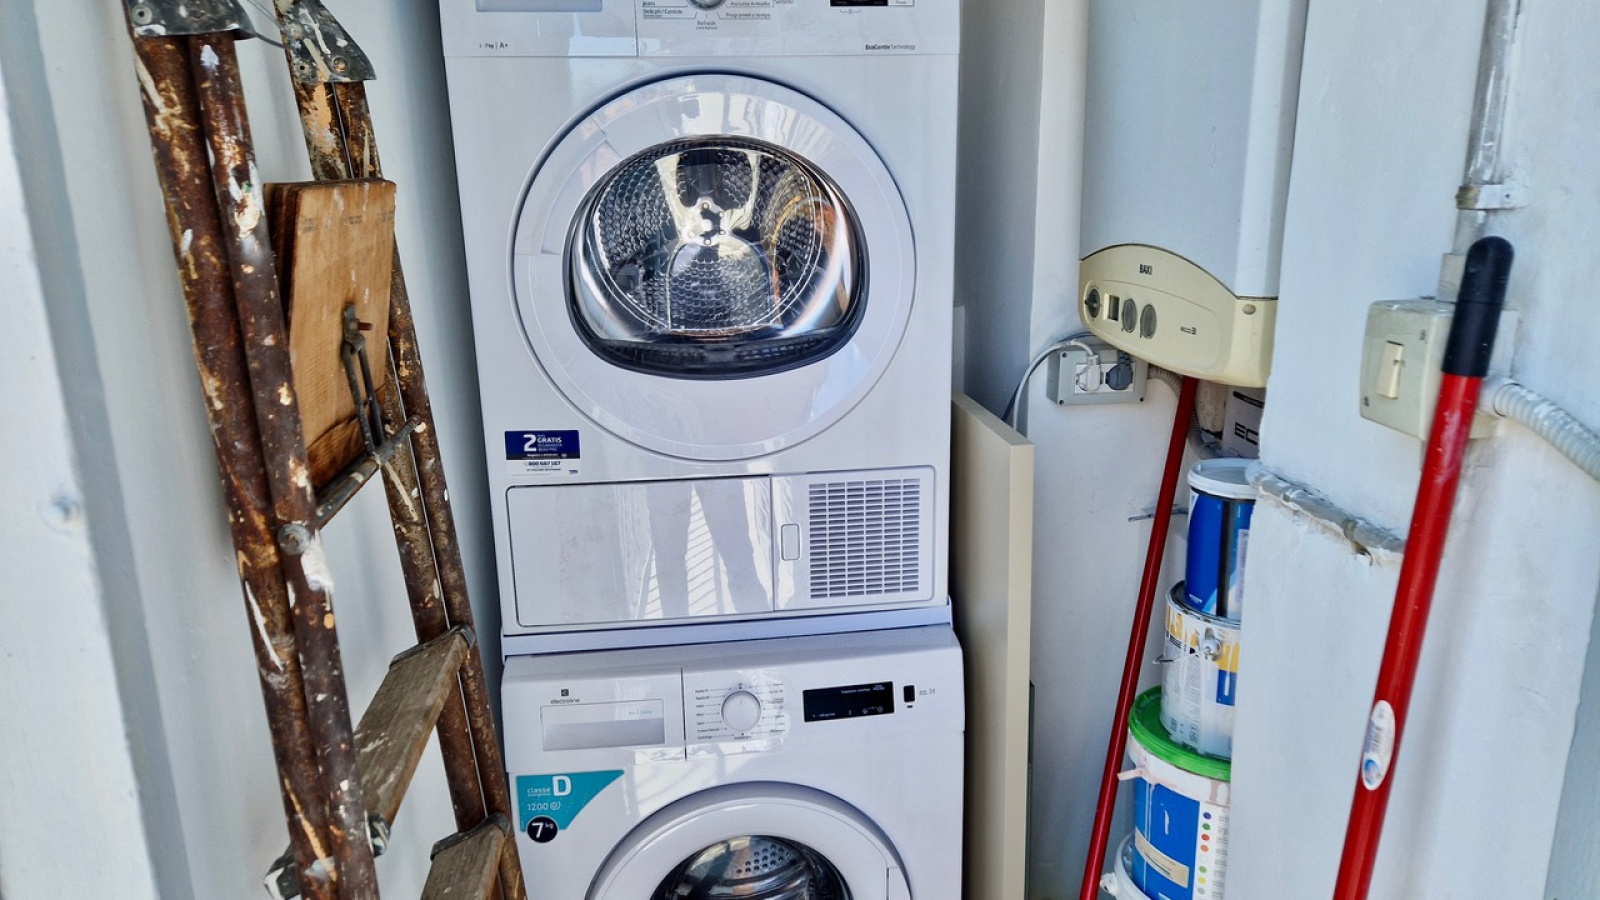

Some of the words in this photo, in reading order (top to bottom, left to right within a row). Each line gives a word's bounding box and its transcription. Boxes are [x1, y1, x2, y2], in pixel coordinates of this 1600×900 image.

[523, 434, 537, 451] 2
[552, 775, 572, 797] D
[527, 801, 549, 811] 1200
[531, 821, 544, 839] 7
